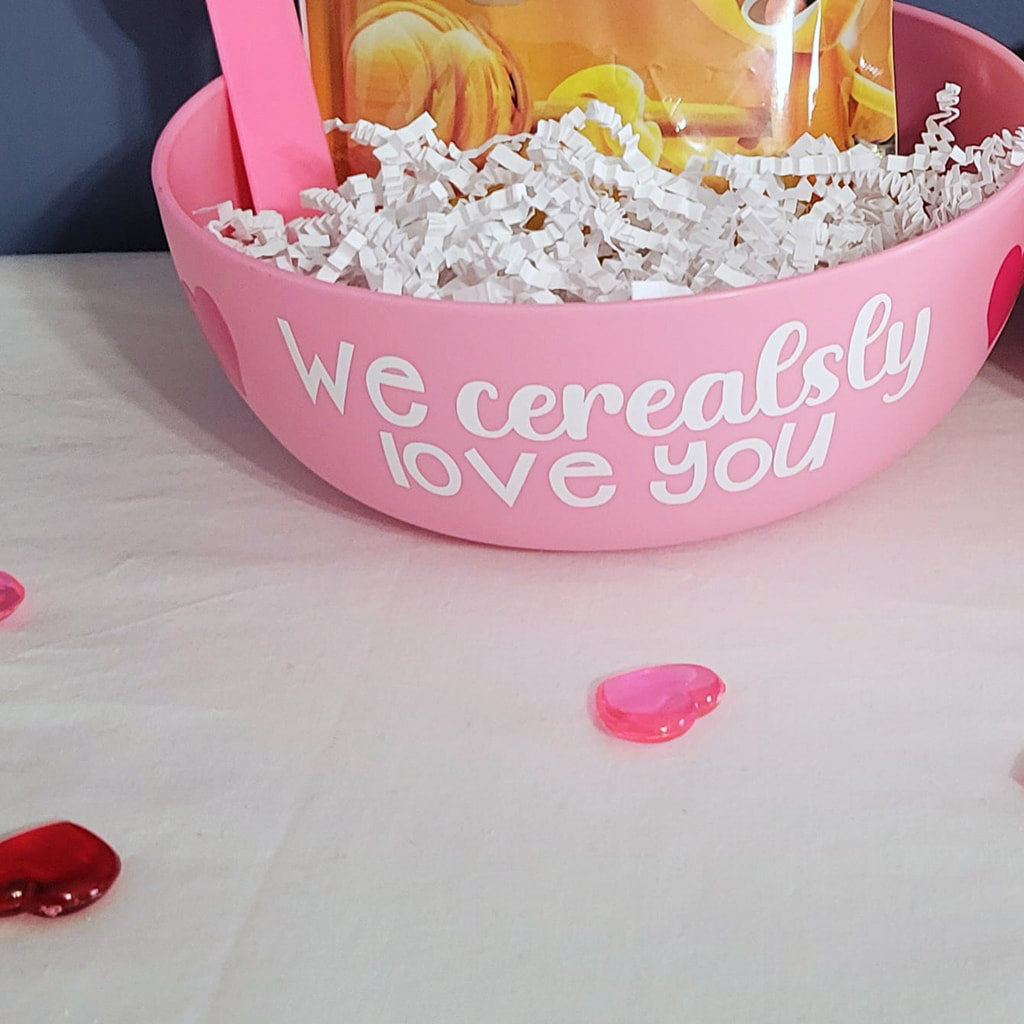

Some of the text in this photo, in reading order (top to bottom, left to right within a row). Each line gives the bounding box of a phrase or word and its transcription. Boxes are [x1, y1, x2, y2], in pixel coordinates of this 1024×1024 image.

[277, 292, 932, 441] We cerealsly
[379, 412, 836, 508] love you
